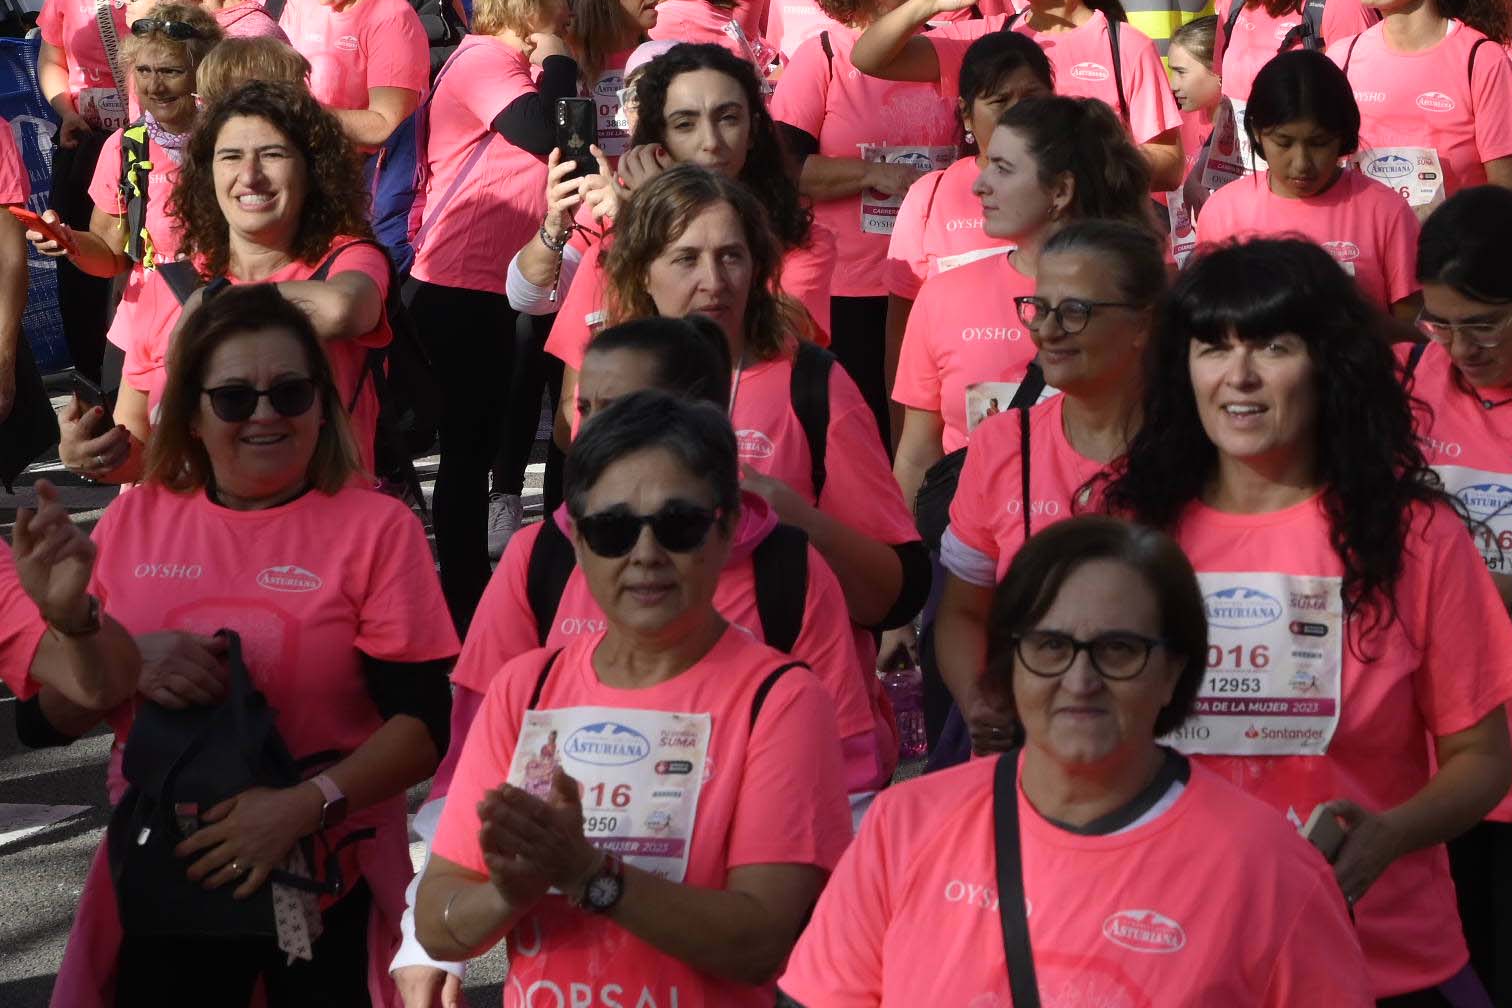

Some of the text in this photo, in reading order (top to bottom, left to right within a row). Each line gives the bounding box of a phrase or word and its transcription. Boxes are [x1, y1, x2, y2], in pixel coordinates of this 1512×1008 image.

[600, 104, 619, 116] 01
[946, 218, 984, 232] OYSH
[961, 327, 1022, 342] OYSHO
[133, 563, 203, 580] OYSHO
[263, 573, 318, 589] ASTURIANA
[1289, 599, 1327, 611] SUMA
[1206, 644, 1270, 669] 016
[1208, 677, 1261, 693] 12953
[1212, 703, 1319, 713] DE LA MUJER 2023
[1261, 726, 1323, 740] Santander
[567, 737, 643, 758] ASTURIANA
[659, 736, 697, 748] SUMA
[579, 782, 633, 808] 16
[1109, 919, 1179, 945] ASTURIANA
